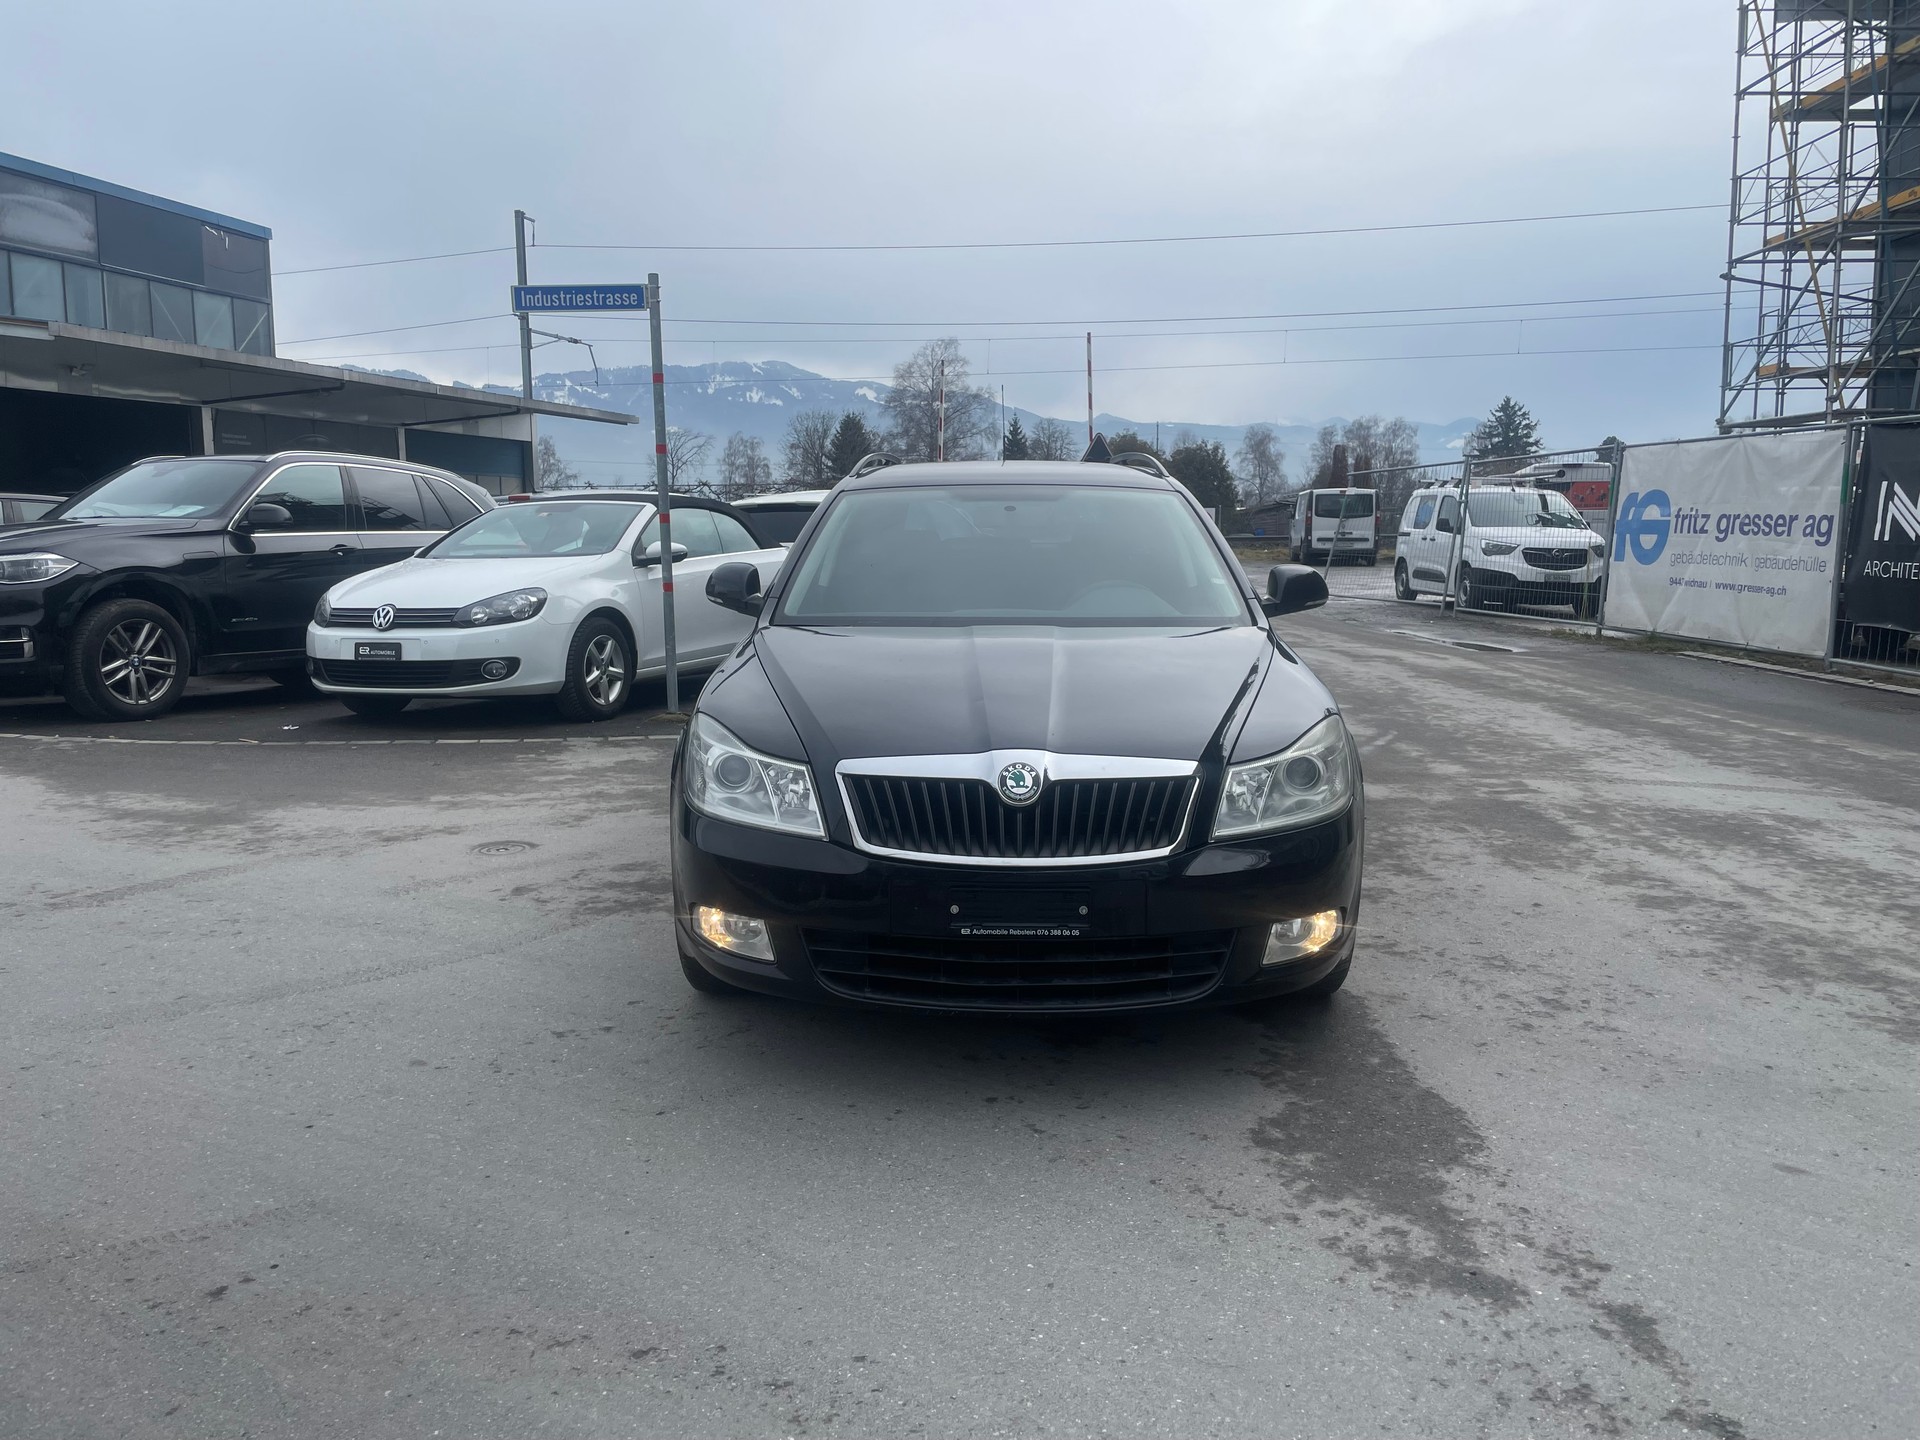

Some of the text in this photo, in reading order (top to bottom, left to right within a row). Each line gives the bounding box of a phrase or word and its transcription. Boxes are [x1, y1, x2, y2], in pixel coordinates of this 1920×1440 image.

[520, 289, 638, 307] Industriestrasse
[1673, 507, 1835, 547] fritz gresser ag
[1670, 550, 1827, 572] gebädetechnik gebäudehülle
[1863, 560, 1920, 580] ARCHITE
[1715, 582, 1787, 597] www.gresser-ag.ch
[1010, 928, 1036, 936] Rebstein
